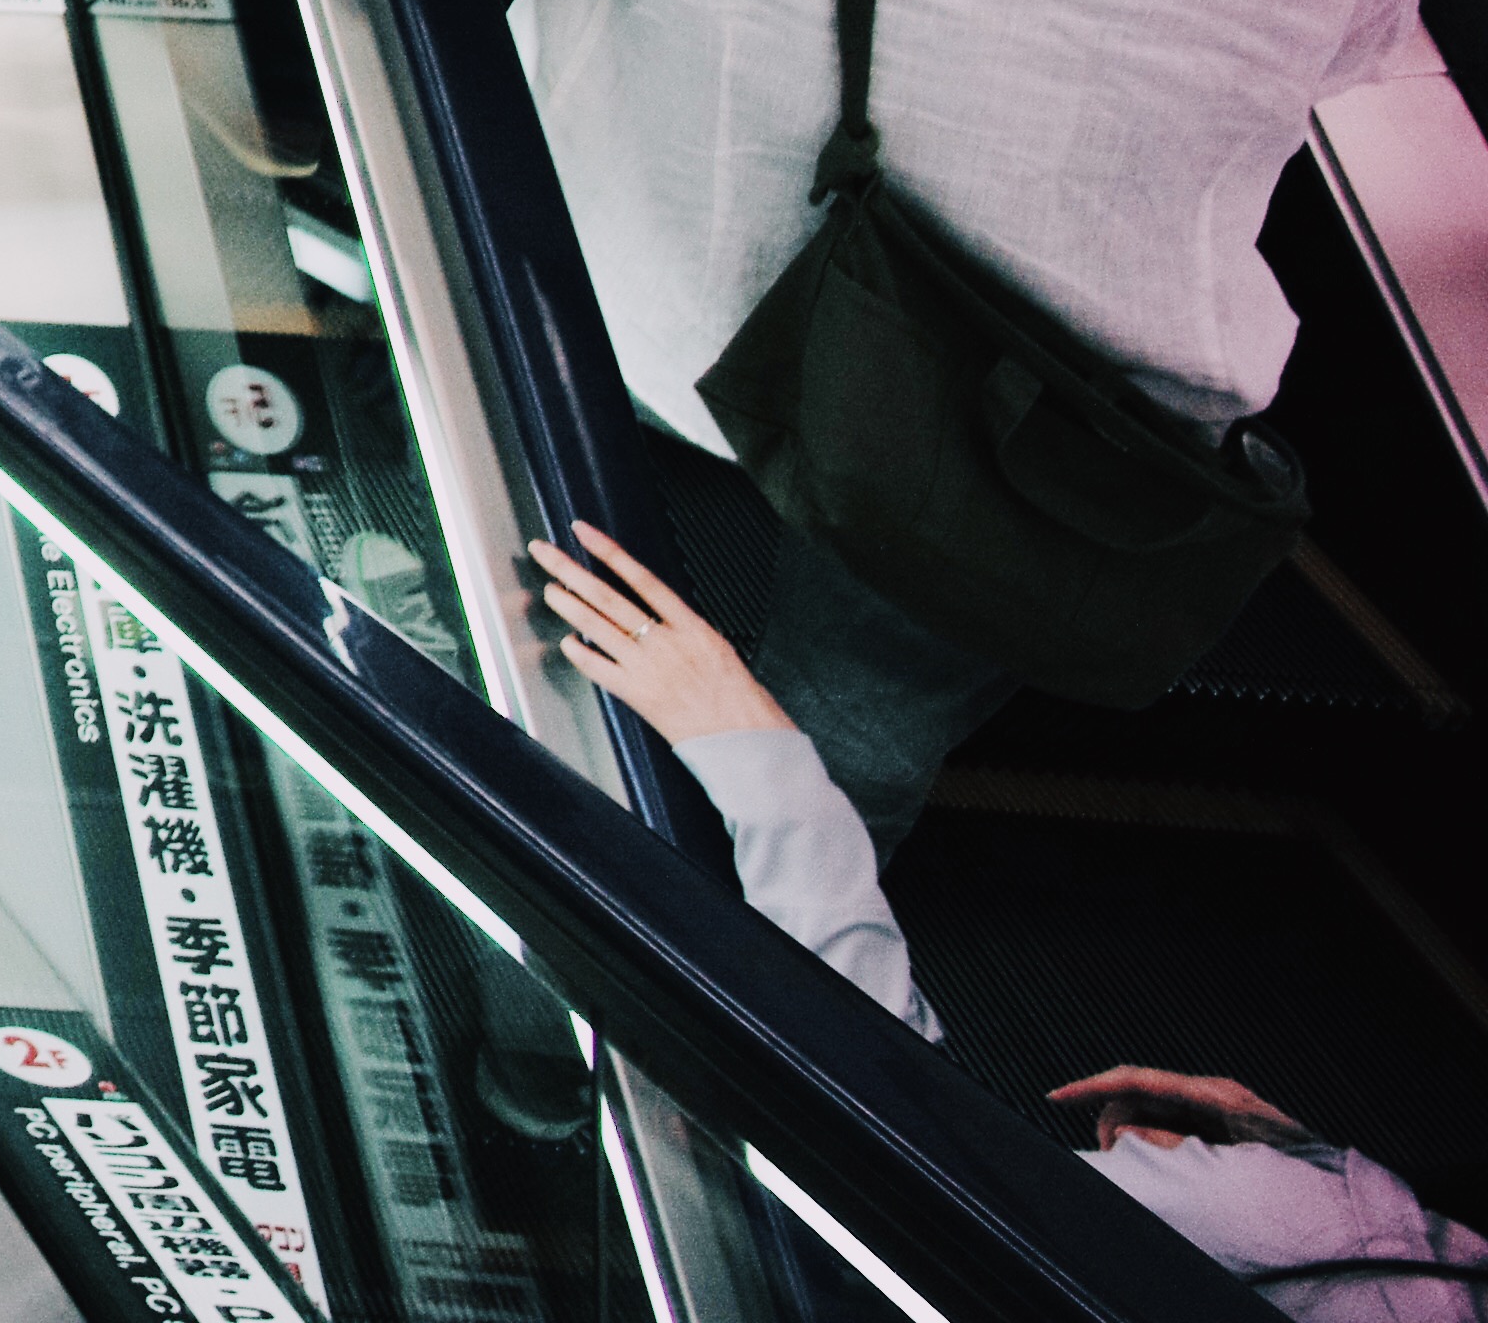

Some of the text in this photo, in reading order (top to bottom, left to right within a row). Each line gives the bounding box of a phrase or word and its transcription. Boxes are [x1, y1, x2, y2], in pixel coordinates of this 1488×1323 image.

[44, 568, 102, 745] Electronics
[2, 1034, 70, 1070] 2F
[14, 1103, 183, 1315] PC peripheral, PC
